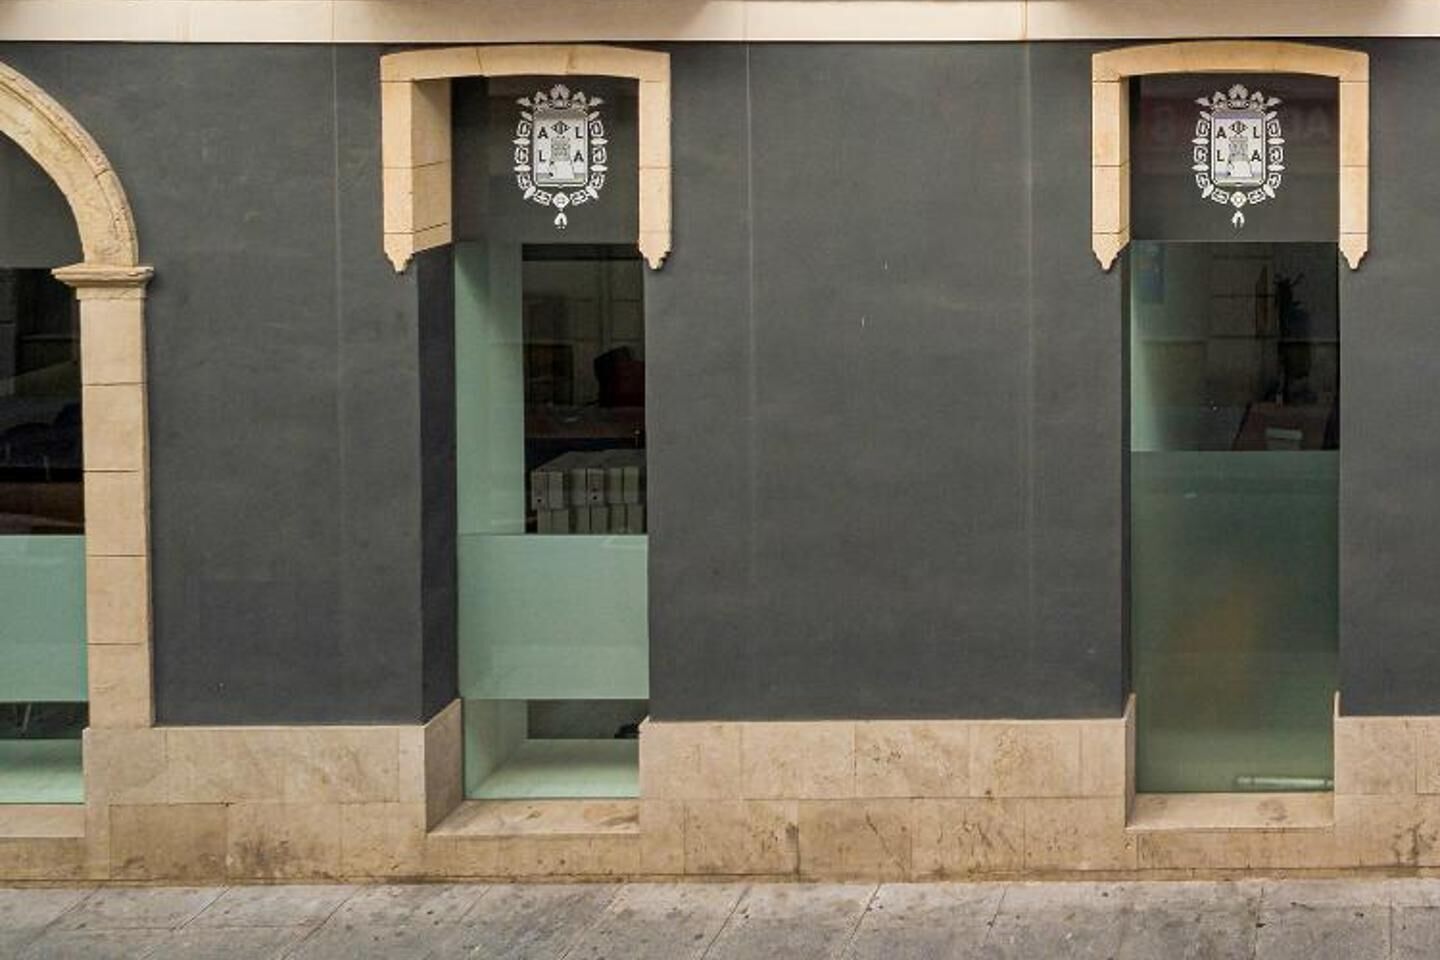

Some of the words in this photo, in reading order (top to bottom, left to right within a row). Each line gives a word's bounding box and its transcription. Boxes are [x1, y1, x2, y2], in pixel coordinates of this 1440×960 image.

[537, 126, 549, 139] A
[575, 127, 583, 139] L
[1216, 126, 1227, 139] A
[1253, 126, 1260, 138] L
[539, 150, 547, 162] L
[573, 150, 584, 162] A
[1216, 150, 1224, 161] L
[1251, 150, 1262, 161] A
